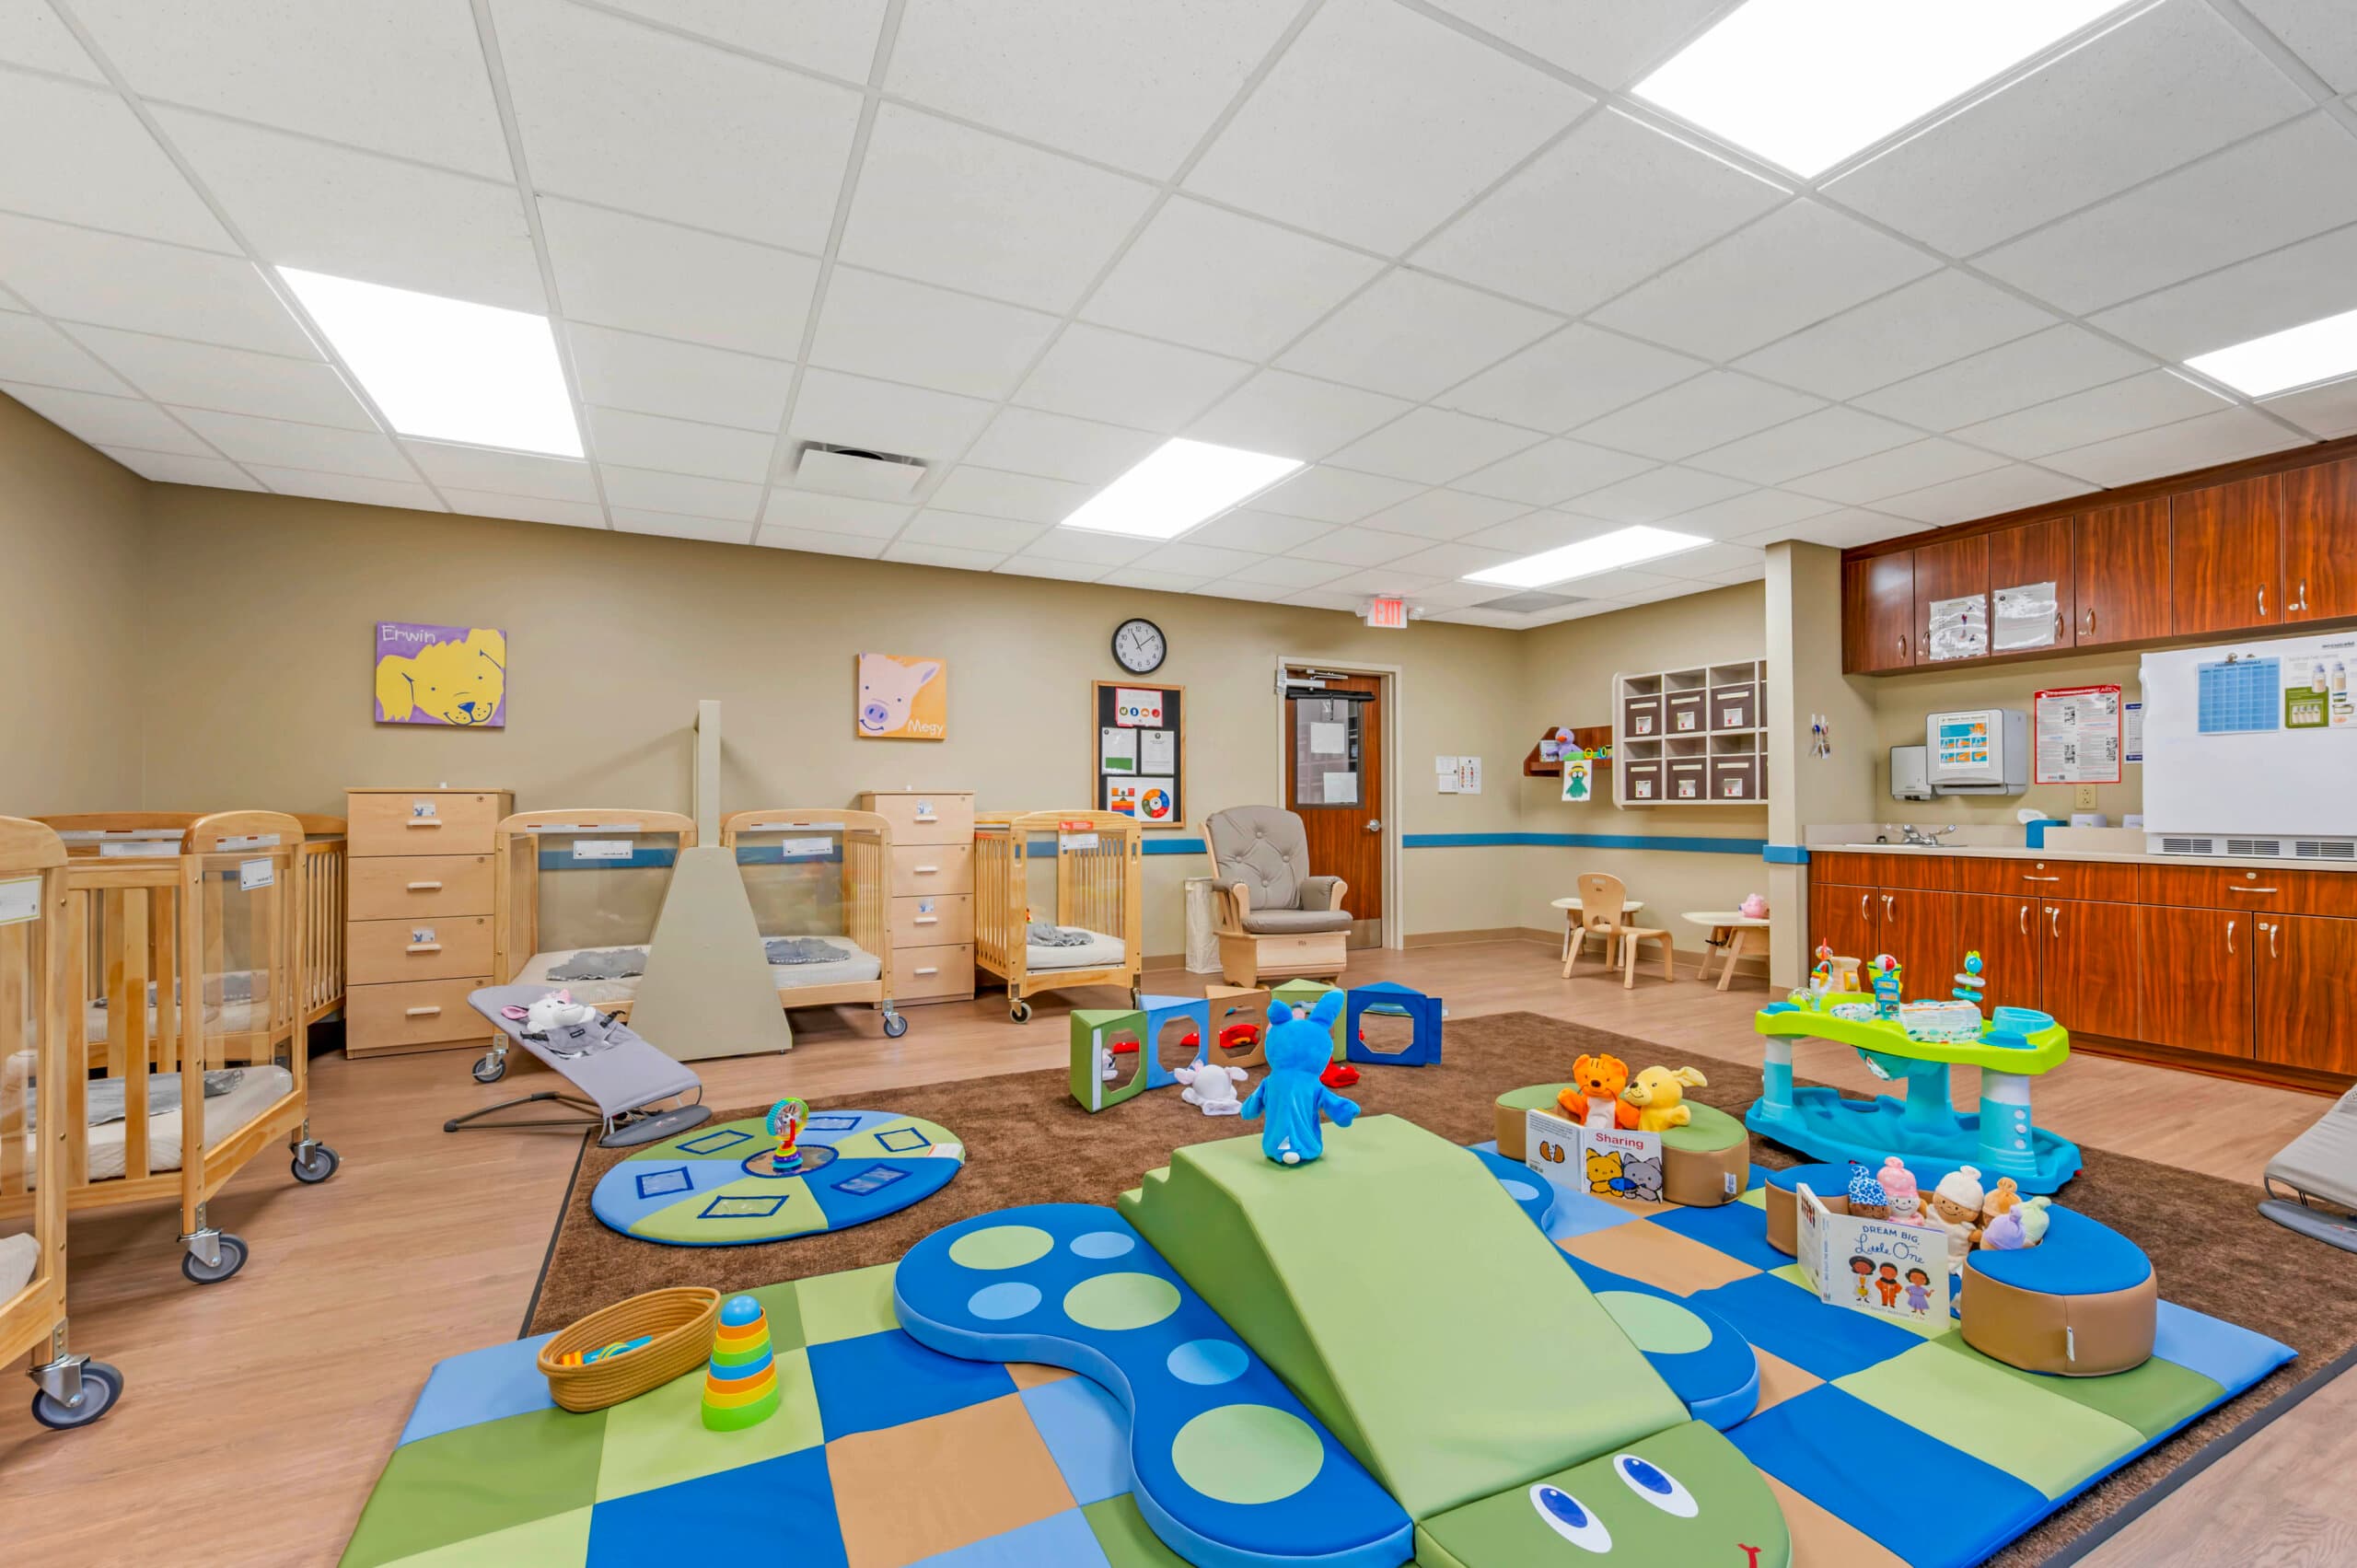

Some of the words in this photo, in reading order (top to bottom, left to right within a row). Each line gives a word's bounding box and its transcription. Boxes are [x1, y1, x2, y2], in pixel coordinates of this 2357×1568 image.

[1375, 598, 1402, 626] EXIT
[381, 625, 435, 644] Erwin
[1596, 1132, 1643, 1150] Sharing
[1863, 1225, 1898, 1237] DREAM
[1900, 1231, 1921, 1246] BIG,
[1854, 1233, 1892, 1256] Little
[1892, 1241, 1925, 1264] One
